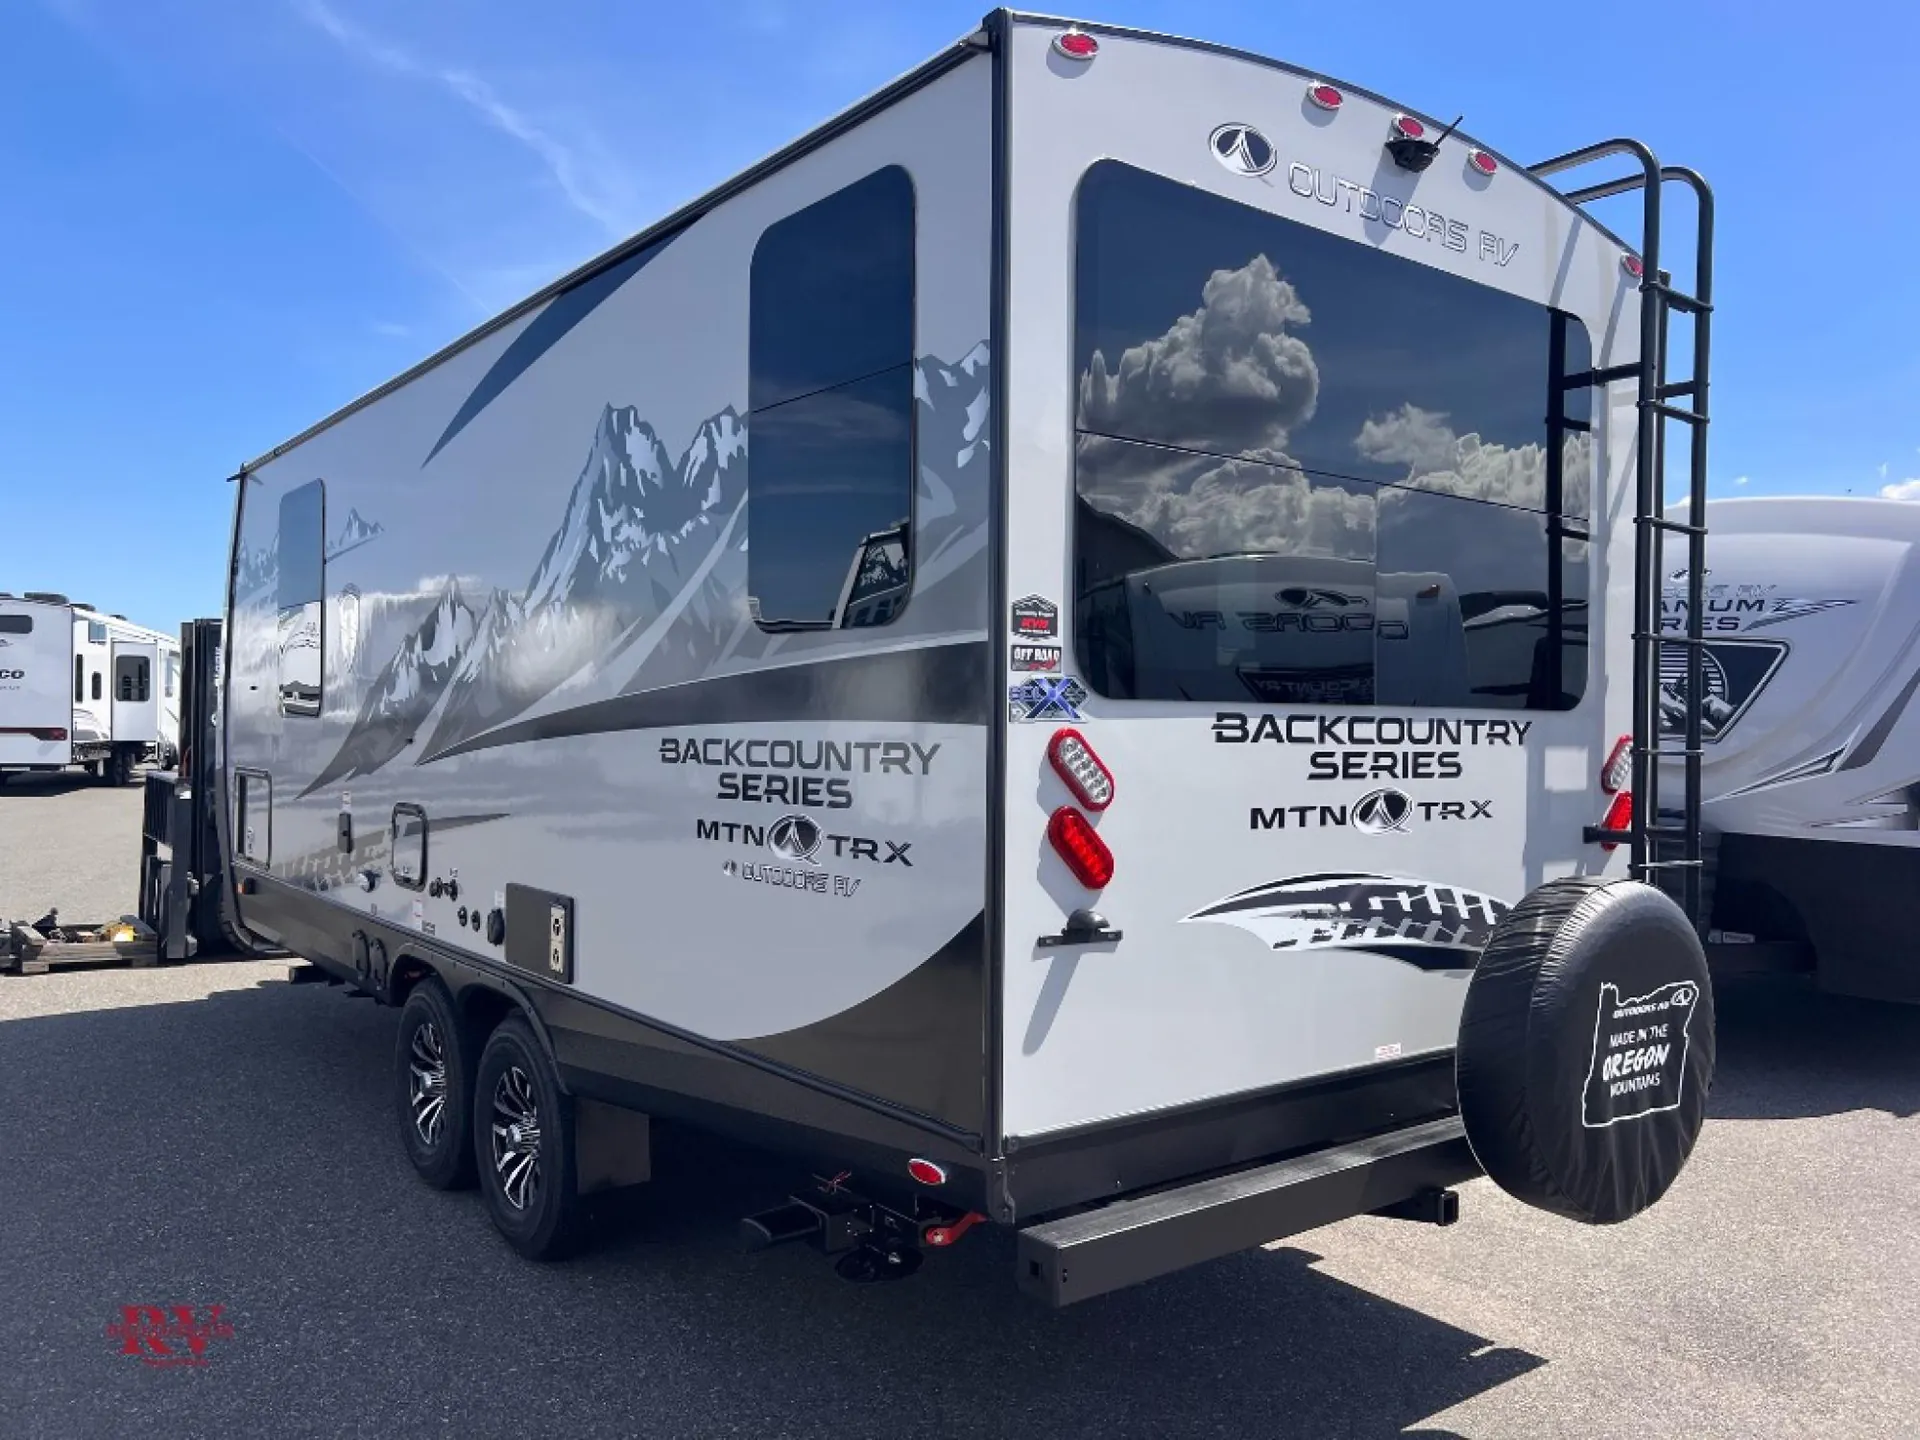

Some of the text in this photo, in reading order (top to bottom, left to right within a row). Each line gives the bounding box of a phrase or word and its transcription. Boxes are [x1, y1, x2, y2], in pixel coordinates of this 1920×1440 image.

[1289, 161, 1520, 267] OUTDOORS RV
[1211, 712, 1532, 746] BACKCOUNTRY
[659, 738, 941, 775] BACKCOUNTRY
[1307, 751, 1463, 780] SERIES
[716, 772, 853, 809] SERIES
[1250, 800, 1493, 829] MTN TRX
[697, 819, 913, 867] MTN TRX
[742, 861, 828, 893] OUTDOORS
[1609, 1023, 1669, 1048] MADE IN THE
[1602, 1043, 1671, 1082] OREGON
